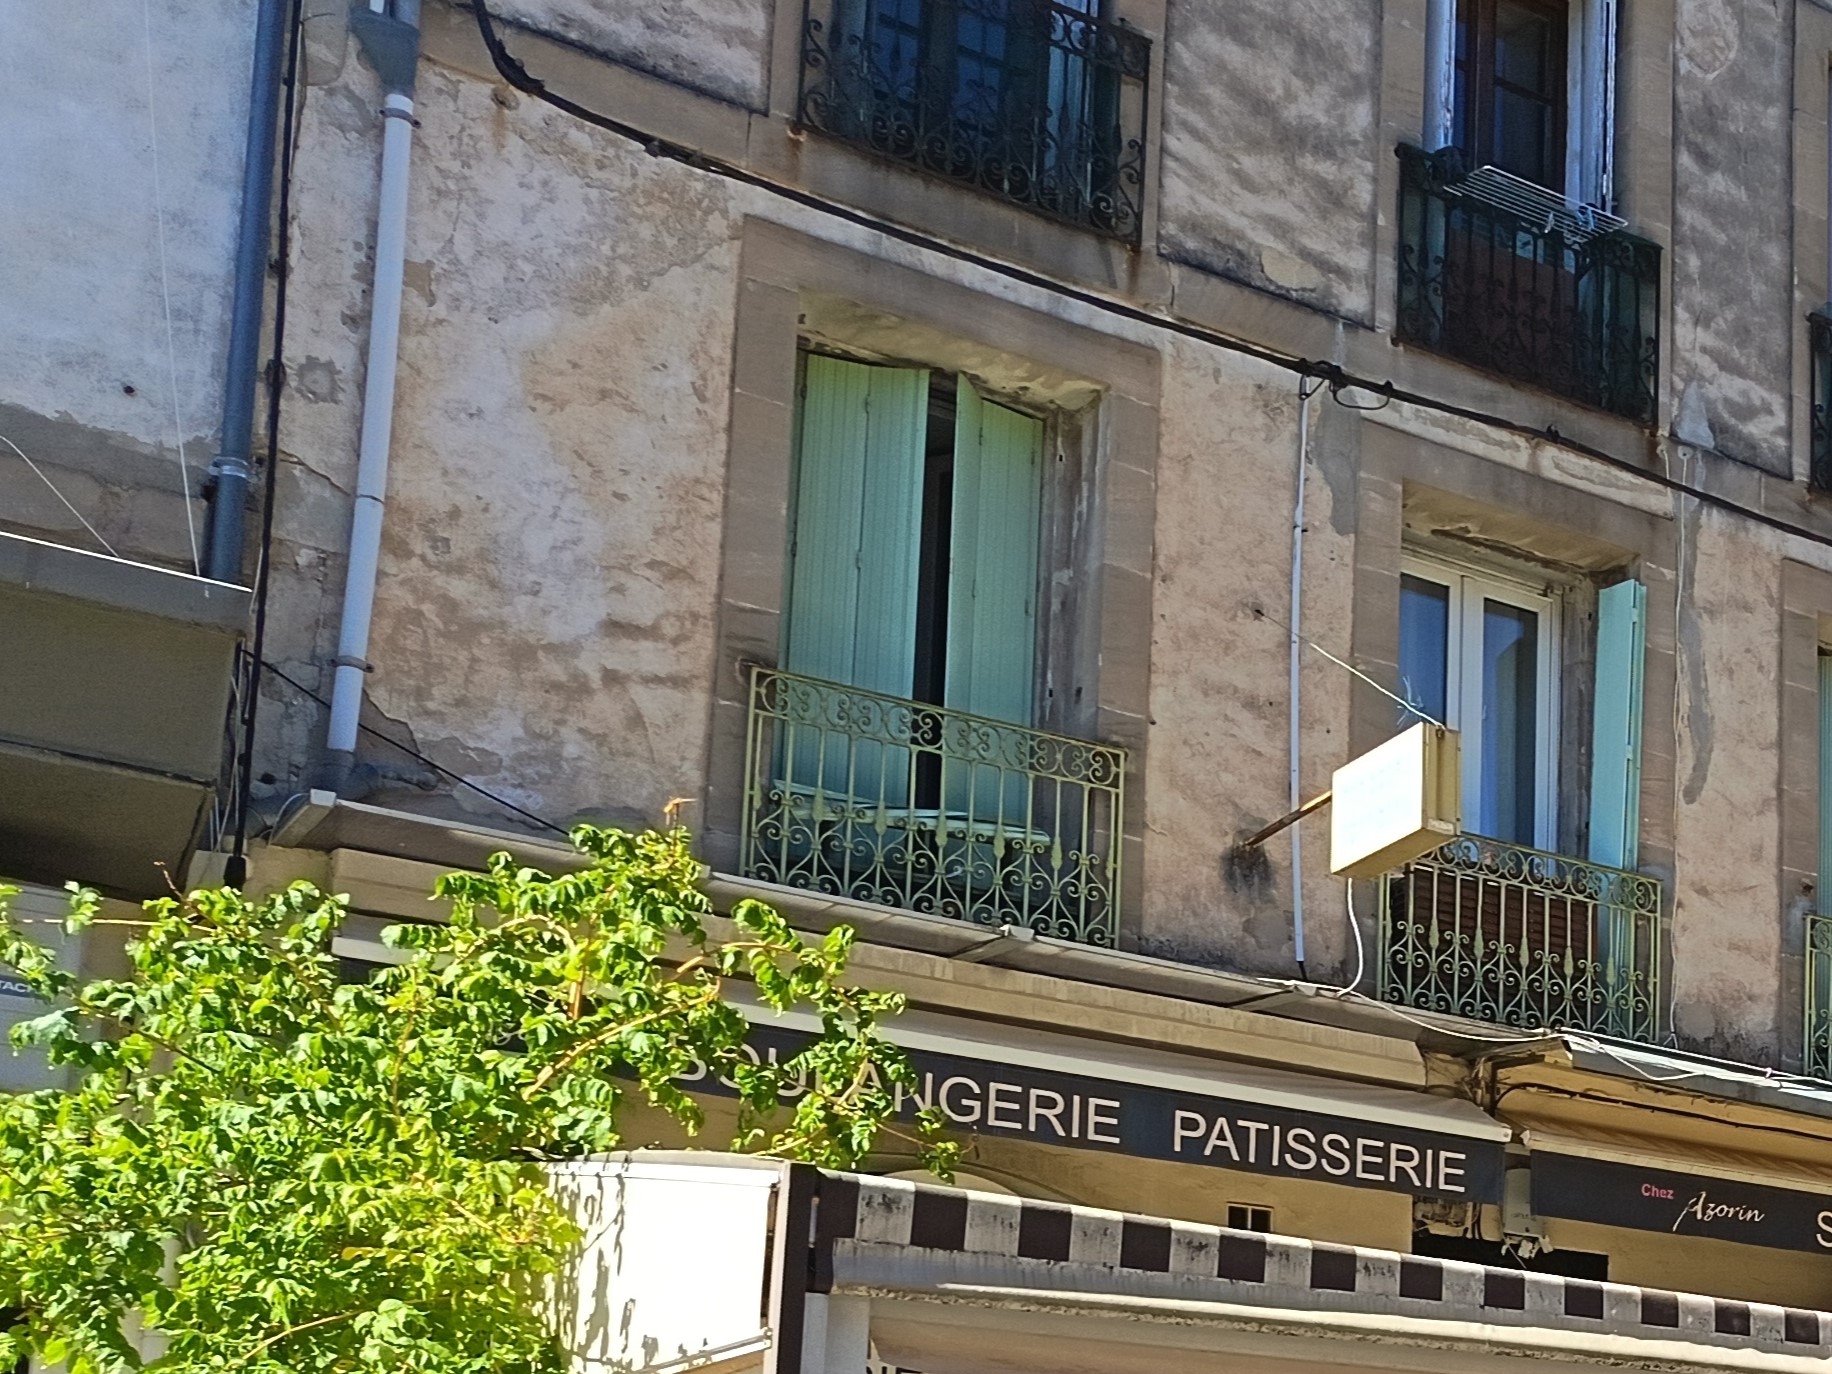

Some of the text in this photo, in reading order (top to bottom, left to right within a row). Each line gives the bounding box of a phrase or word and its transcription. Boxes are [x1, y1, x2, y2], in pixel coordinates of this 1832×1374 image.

[1173, 1110, 1466, 1193] PATISSERIE
[1641, 1183, 1765, 1232] Chez Azorin
